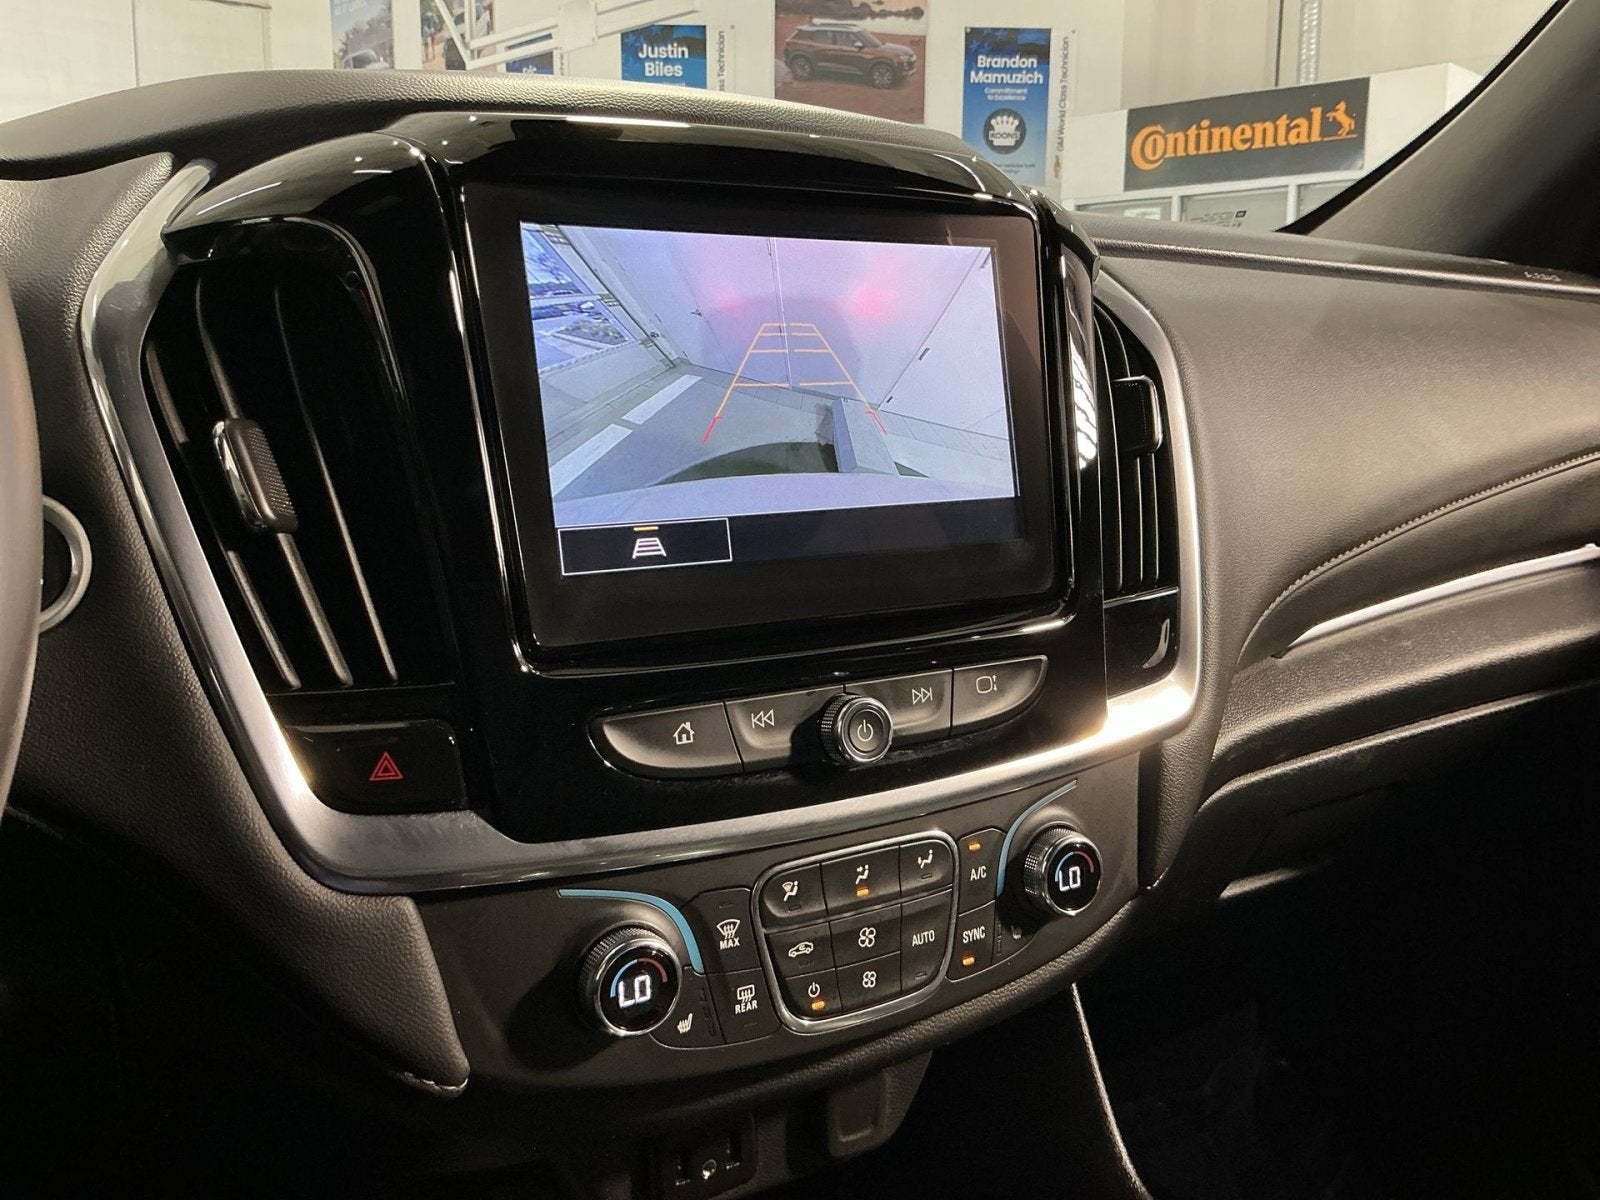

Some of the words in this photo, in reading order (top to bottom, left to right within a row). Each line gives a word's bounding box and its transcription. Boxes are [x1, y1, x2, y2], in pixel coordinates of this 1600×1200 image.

[637, 42, 689, 59] Justin
[717, 30, 726, 77] Technician
[644, 60, 684, 77] Biles
[976, 52, 1038, 69] Brandon
[1059, 36, 1070, 84] Technician
[969, 69, 1044, 85] Mamuzich
[1058, 84, 1068, 109] Class
[1057, 110, 1067, 136] World
[989, 131, 1020, 140] KOONS
[1130, 106, 1323, 171] Continental
[969, 866, 988, 882] A/C
[911, 929, 936, 947] AUTO
[962, 926, 986, 944] SYNC
[719, 937, 741, 951] MAX
[734, 999, 759, 1015] REAR
